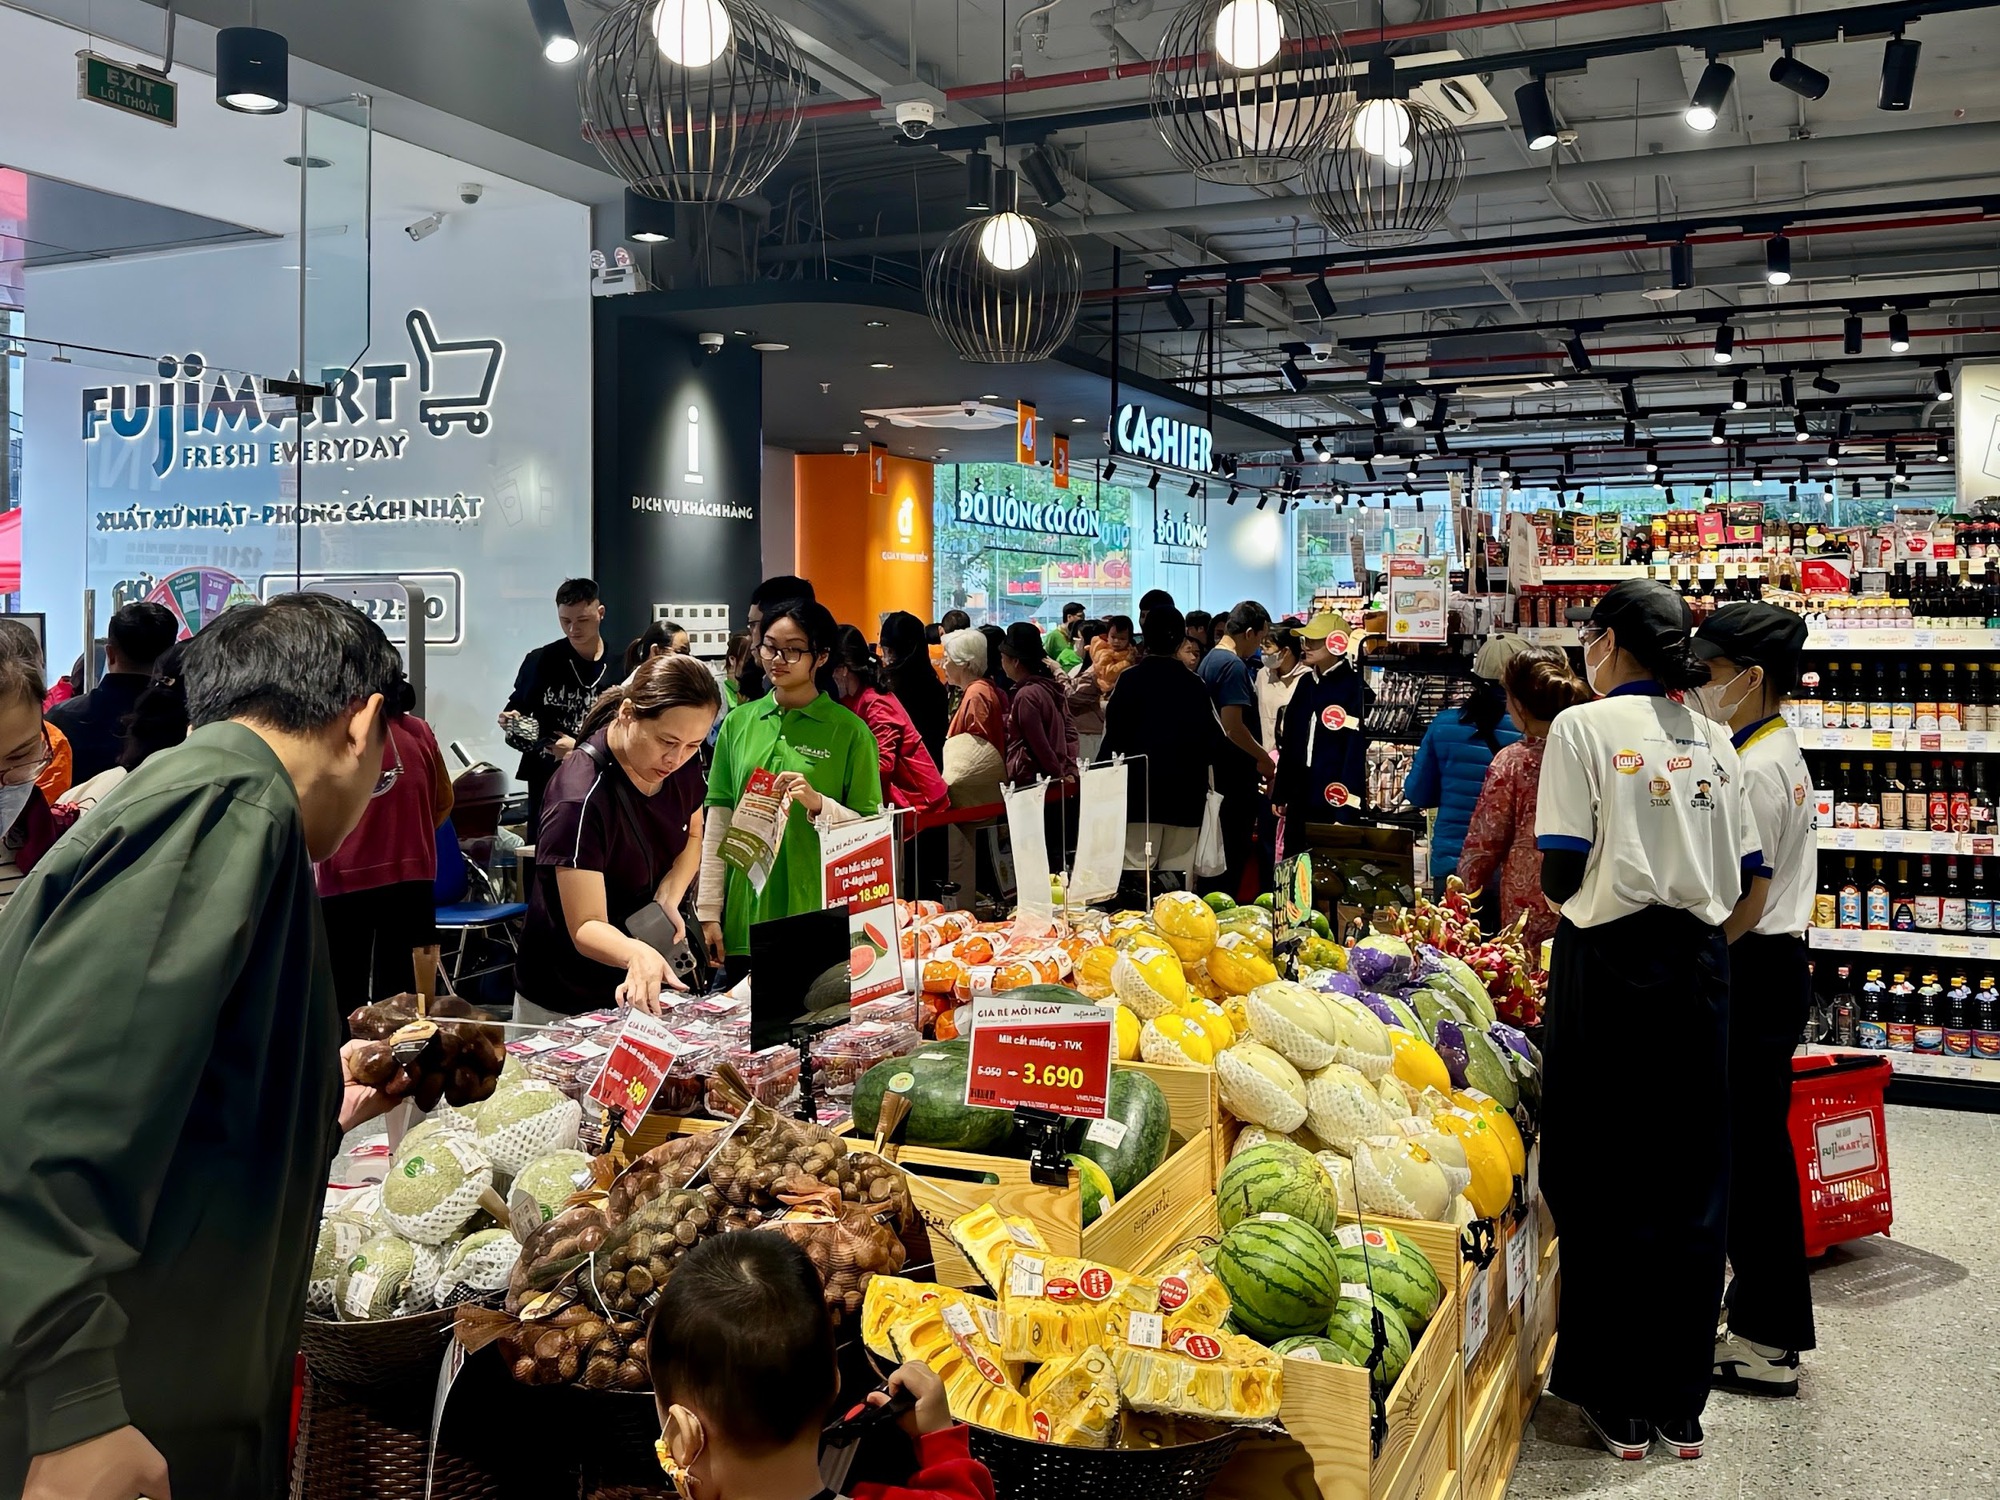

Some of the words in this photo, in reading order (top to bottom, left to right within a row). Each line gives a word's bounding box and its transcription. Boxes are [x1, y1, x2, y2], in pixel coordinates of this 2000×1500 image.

[106, 67, 155, 97] EXIT
[1021, 417, 1033, 451] 4
[1117, 403, 1213, 474] CASHIER
[182, 442, 257, 469] FRESH
[269, 434, 408, 466] EVERYDAY
[1056, 447, 1065, 477] 3
[875, 456, 883, 483] 1
[186, 501, 247, 533] NHẬT
[345, 494, 407, 523] CÁCH
[411, 492, 483, 524] NHẬT
[632, 496, 662, 514] DỊCH
[663, 499, 680, 517] VỤ
[681, 498, 721, 518] KHÁCH
[721, 501, 753, 520] HÀNG
[958, 477, 989, 525] ĐỒ
[992, 483, 1042, 533] UỐNG
[1044, 498, 1067, 535] CÓ
[1068, 494, 1099, 537] CỒN
[1157, 508, 1174, 545] ĐỒ
[1177, 511, 1207, 549] UỐNG
[1650, 798, 1671, 808] STAX
[859, 882, 890, 903] 18.900
[1063, 1040, 1083, 1051] TVK
[1022, 1062, 1084, 1089] 3.690
